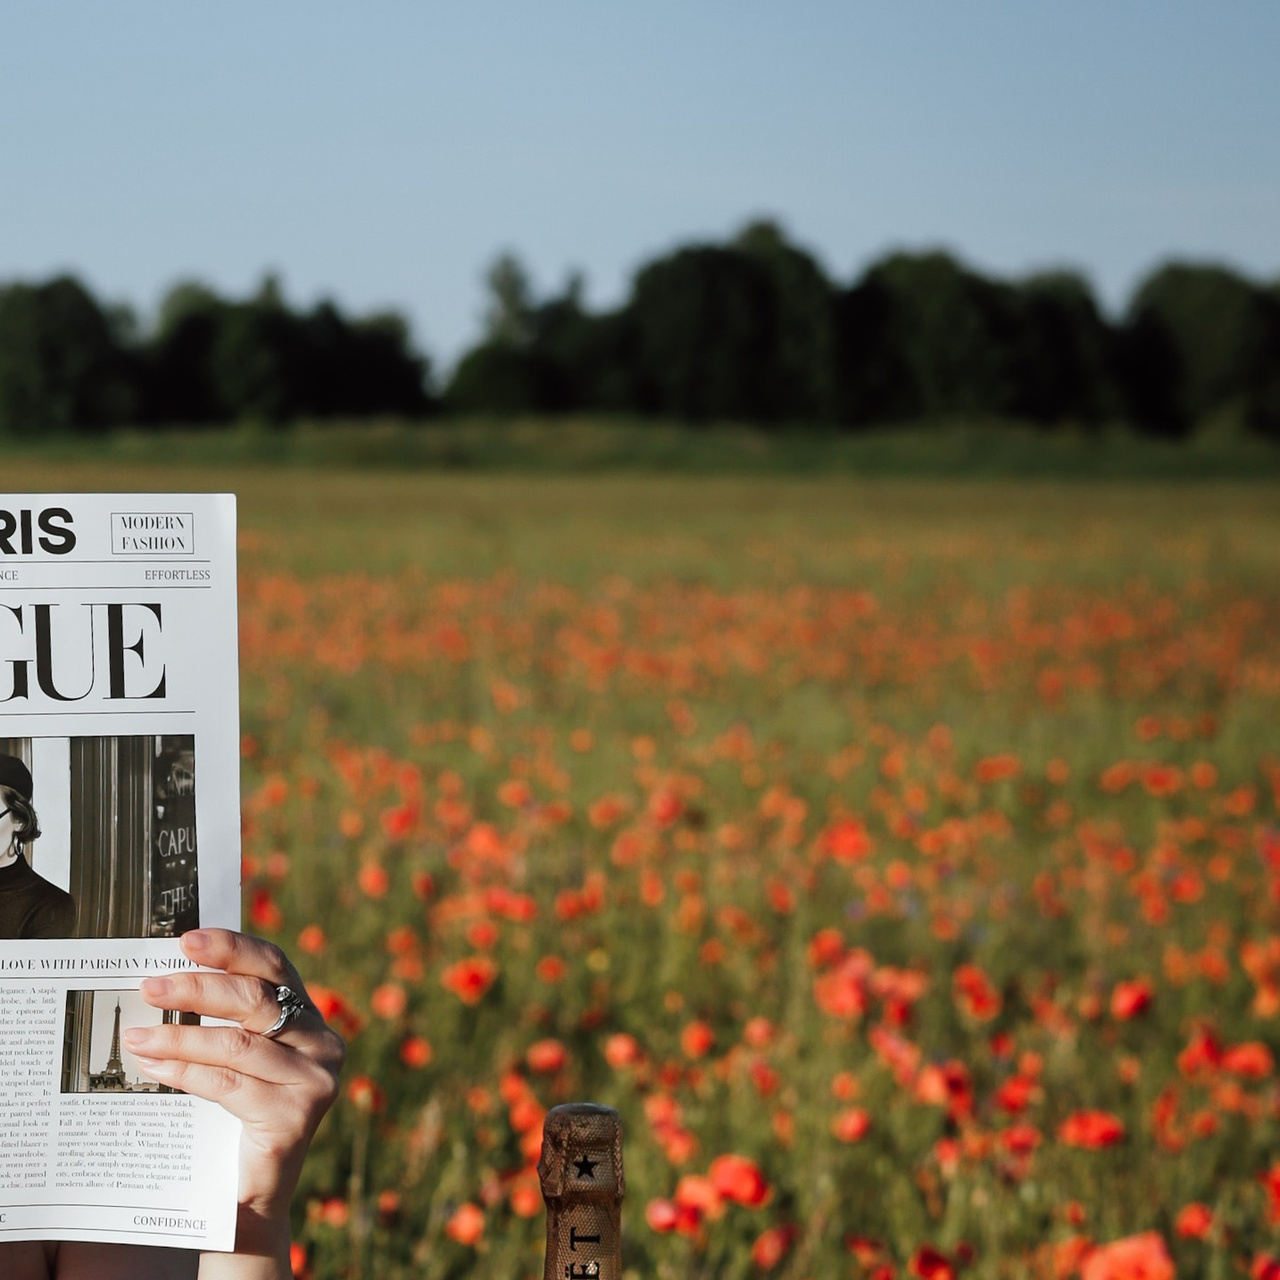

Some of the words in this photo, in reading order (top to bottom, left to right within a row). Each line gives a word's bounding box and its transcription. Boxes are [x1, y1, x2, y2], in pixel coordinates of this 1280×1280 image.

[121, 515, 185, 530] MODERN
[122, 536, 185, 550] FASHION
[144, 567, 211, 581] EFFORTLESS
[0, 959, 36, 971] LOVE
[40, 958, 76, 970] WITH
[81, 957, 139, 970] PARISIAN
[133, 1214, 207, 1231] CONFIDENCE
